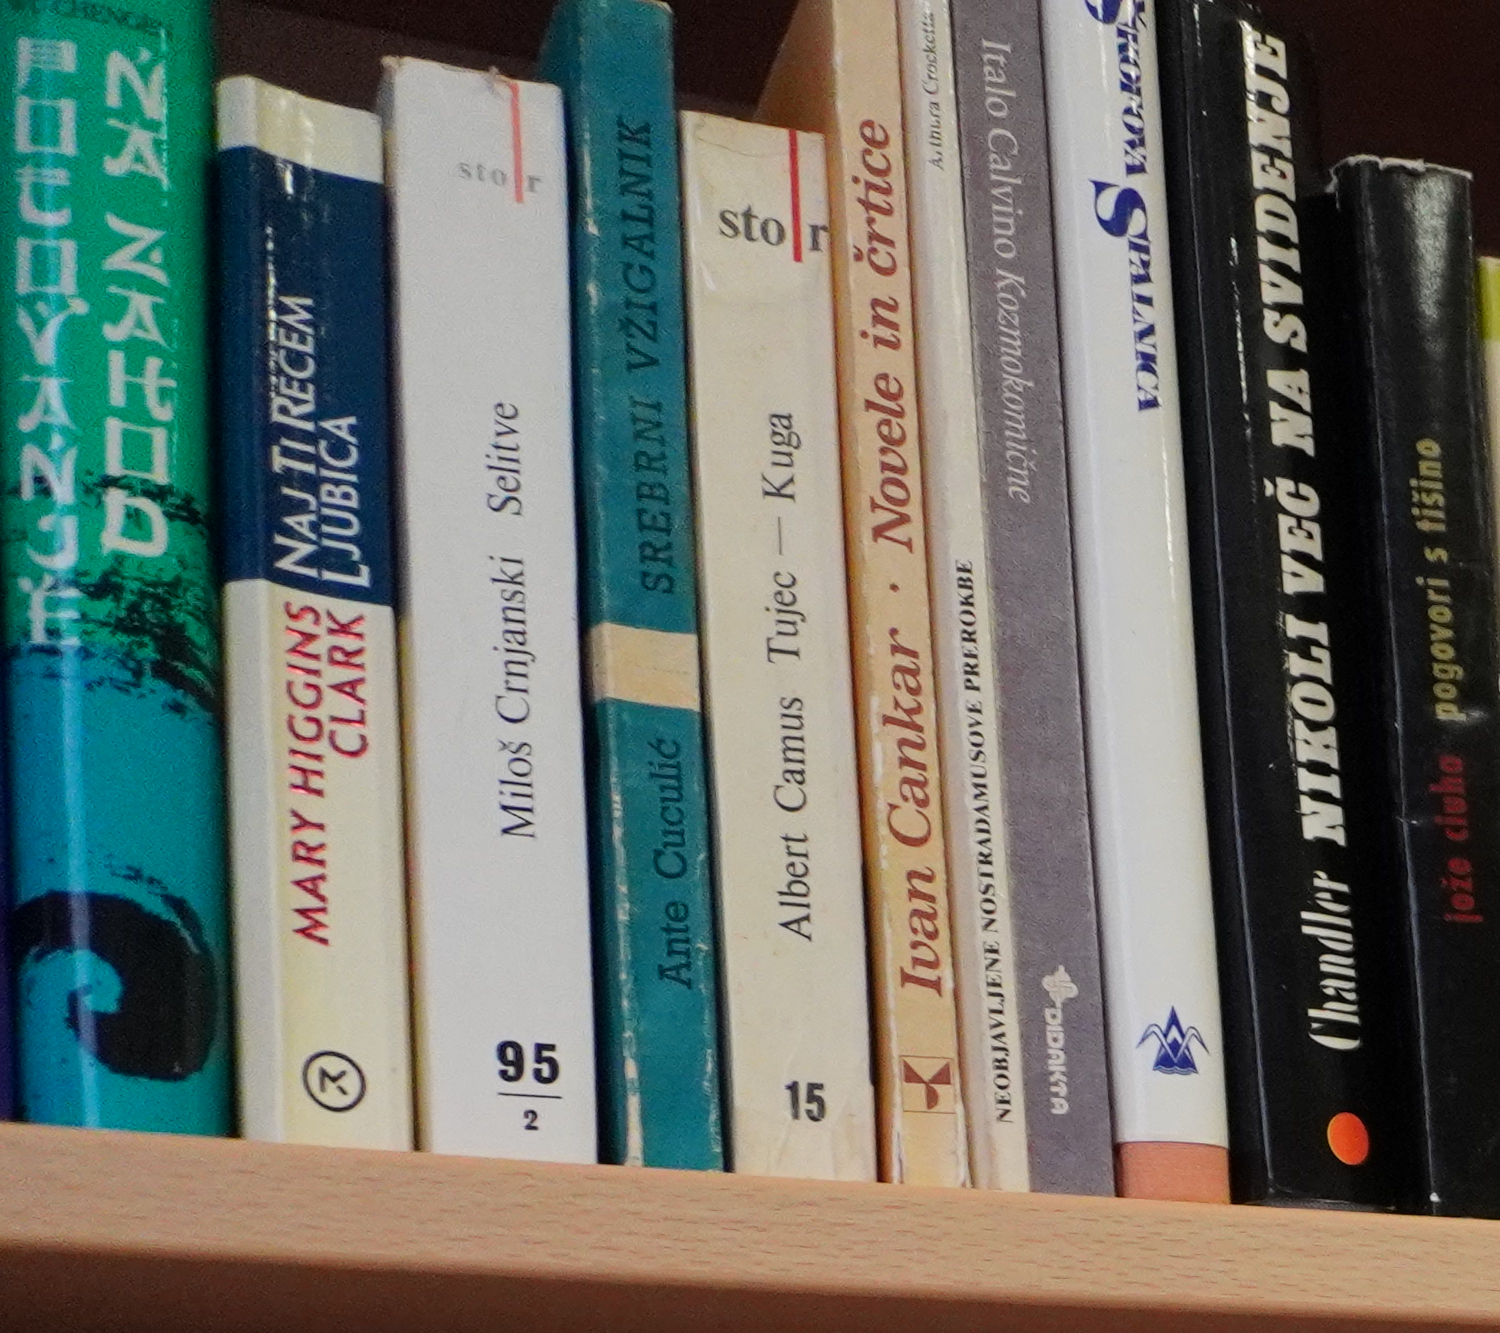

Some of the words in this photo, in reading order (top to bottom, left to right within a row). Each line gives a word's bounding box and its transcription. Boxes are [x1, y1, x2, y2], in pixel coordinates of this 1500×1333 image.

[981, 38, 1018, 117] Italo
[850, 117, 900, 279] črtice
[984, 127, 1027, 262] Calvino
[1243, 28, 1312, 353] SVIDENJE
[268, 295, 315, 425] REČEM
[860, 295, 905, 353] in
[988, 269, 1037, 505] Kozmokomične
[276, 429, 315, 475] TI
[485, 400, 526, 518] Selitve
[760, 410, 803, 505] Kuga
[866, 371, 917, 554] Novele
[1276, 368, 1317, 457] NA
[274, 482, 319, 579] NAJ
[321, 413, 371, 587] LJUBICA
[1263, 479, 1322, 594] VEČ
[323, 607, 368, 760] CLARK
[491, 552, 536, 726] Crnjanski
[763, 569, 805, 665] Tujec
[284, 599, 325, 797] HIGGINS
[773, 695, 808, 815] Camus
[882, 625, 935, 848] Cankar
[1279, 617, 1347, 848] NIKOLI
[496, 738, 538, 841] Miloš
[648, 735, 689, 882] Cuculić
[289, 806, 330, 947] MARY
[656, 894, 696, 990] Ante
[775, 831, 813, 942] Albert
[897, 863, 945, 997] Ivan
[1302, 868, 1363, 1051] Chandler
